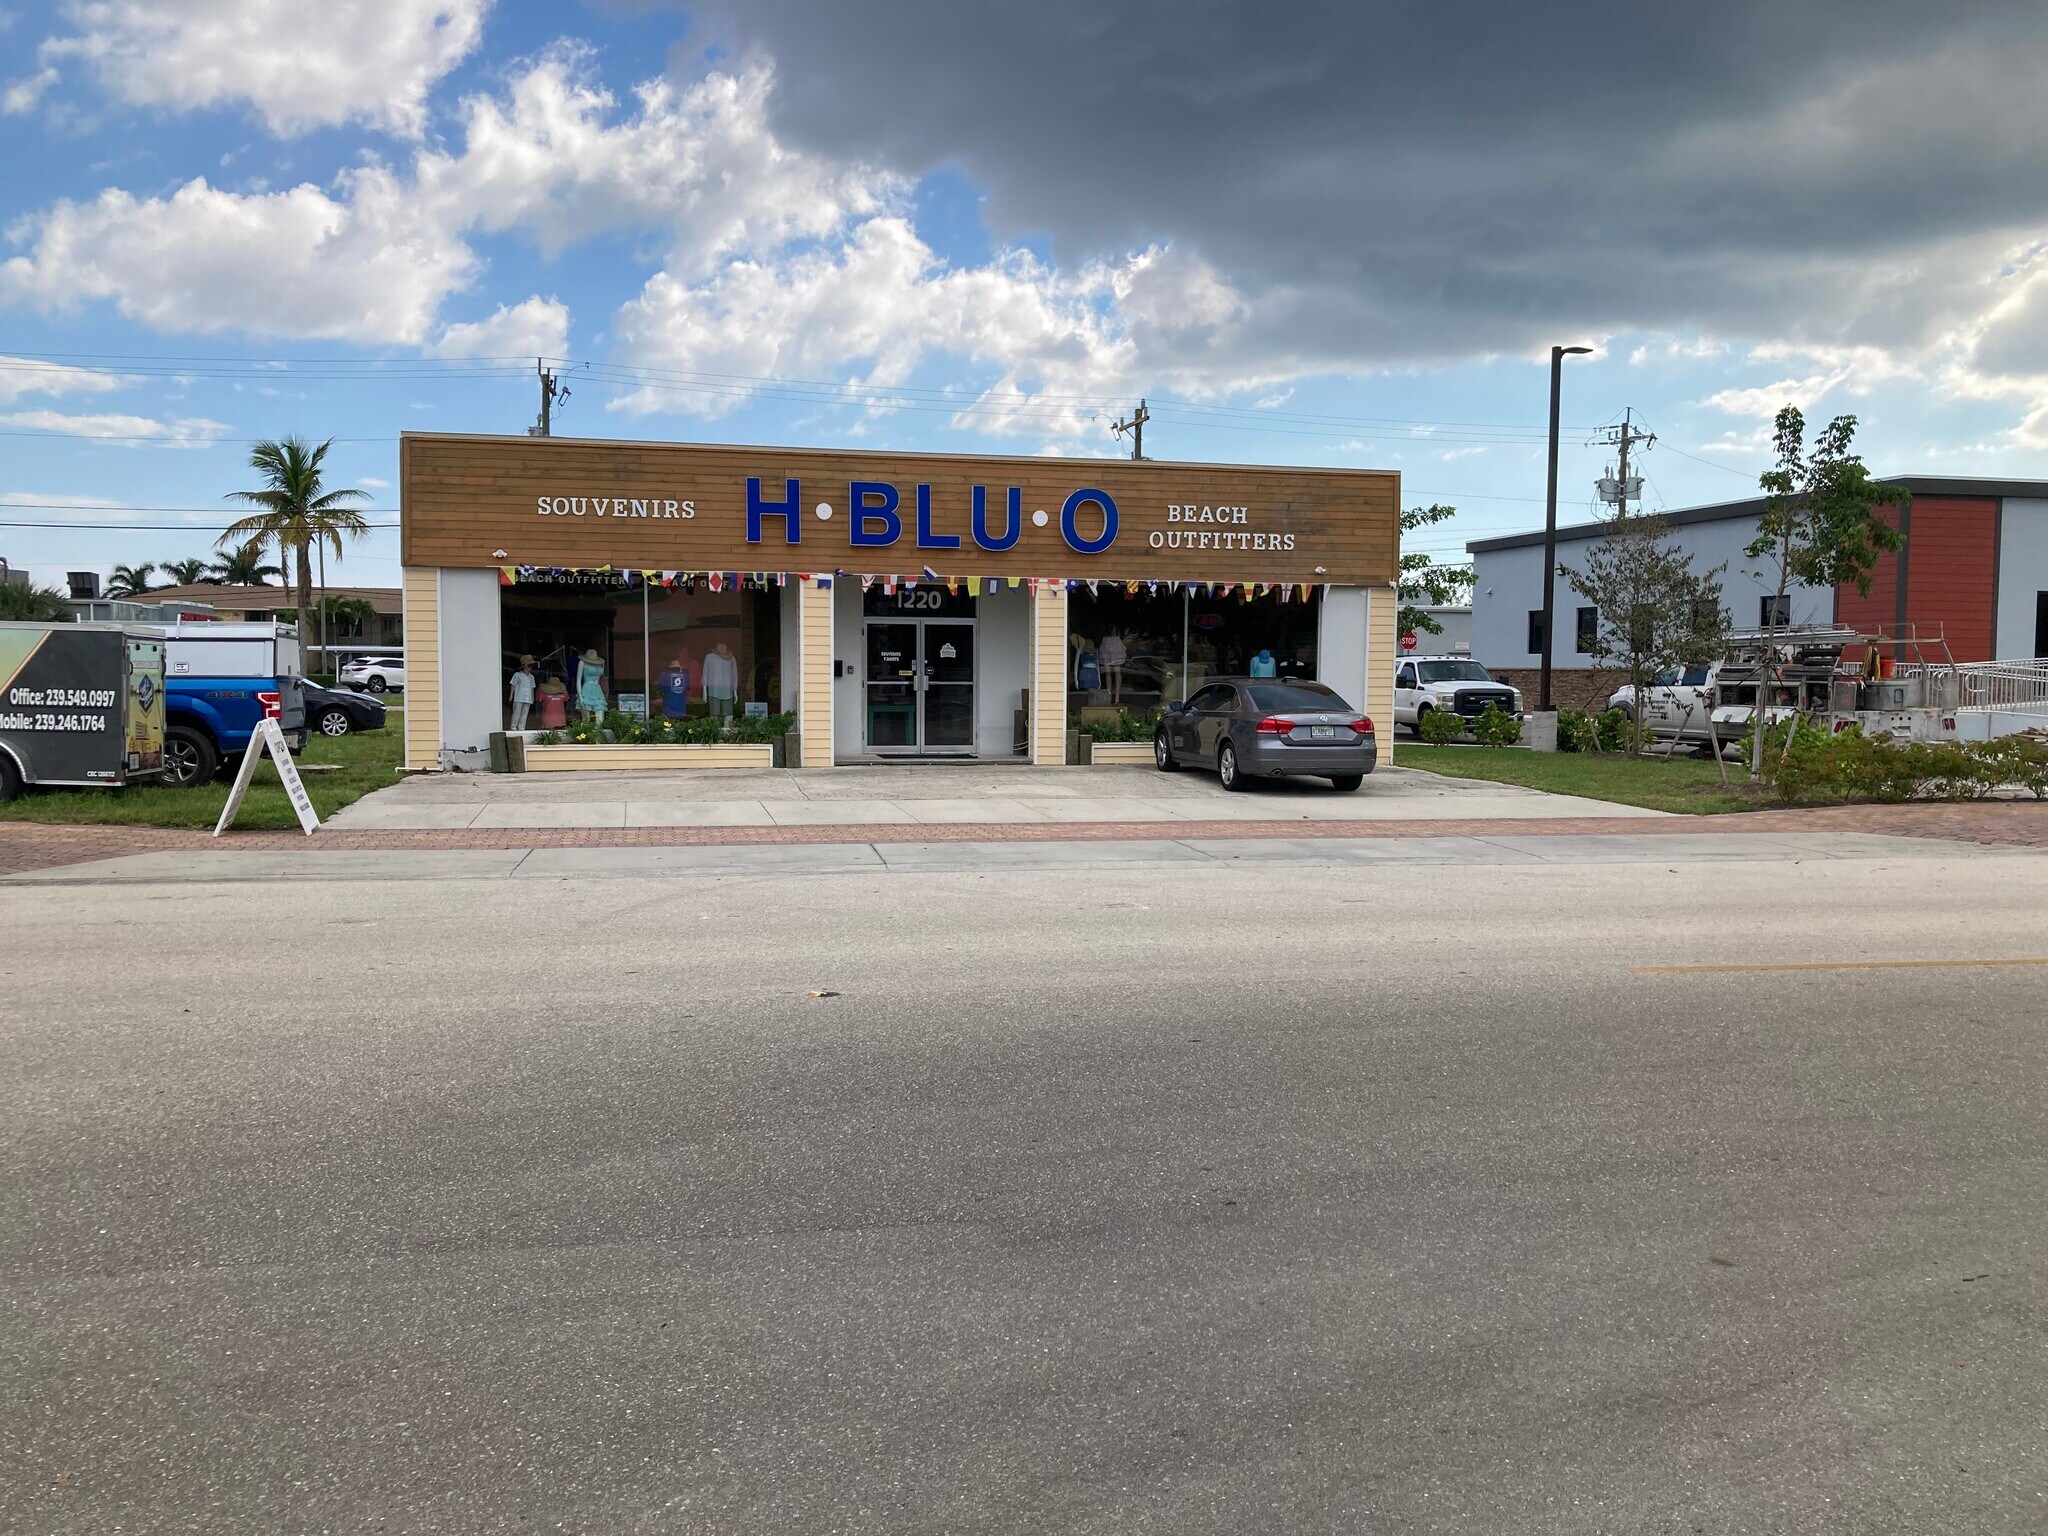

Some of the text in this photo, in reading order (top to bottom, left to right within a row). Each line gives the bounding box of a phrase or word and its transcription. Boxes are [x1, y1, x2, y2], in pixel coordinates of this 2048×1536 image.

[537, 496, 695, 519] SOUVENIRS
[1167, 504, 1248, 524] BEACH
[1149, 531, 1295, 551] OUTFITTERS
[558, 575, 630, 586] OUTFITTER
[897, 590, 942, 609] 1220
[1401, 637, 1416, 645] STOP
[10, 687, 116, 707] Office: 239.549.0997
[35, 714, 106, 731] 239.246.1764
